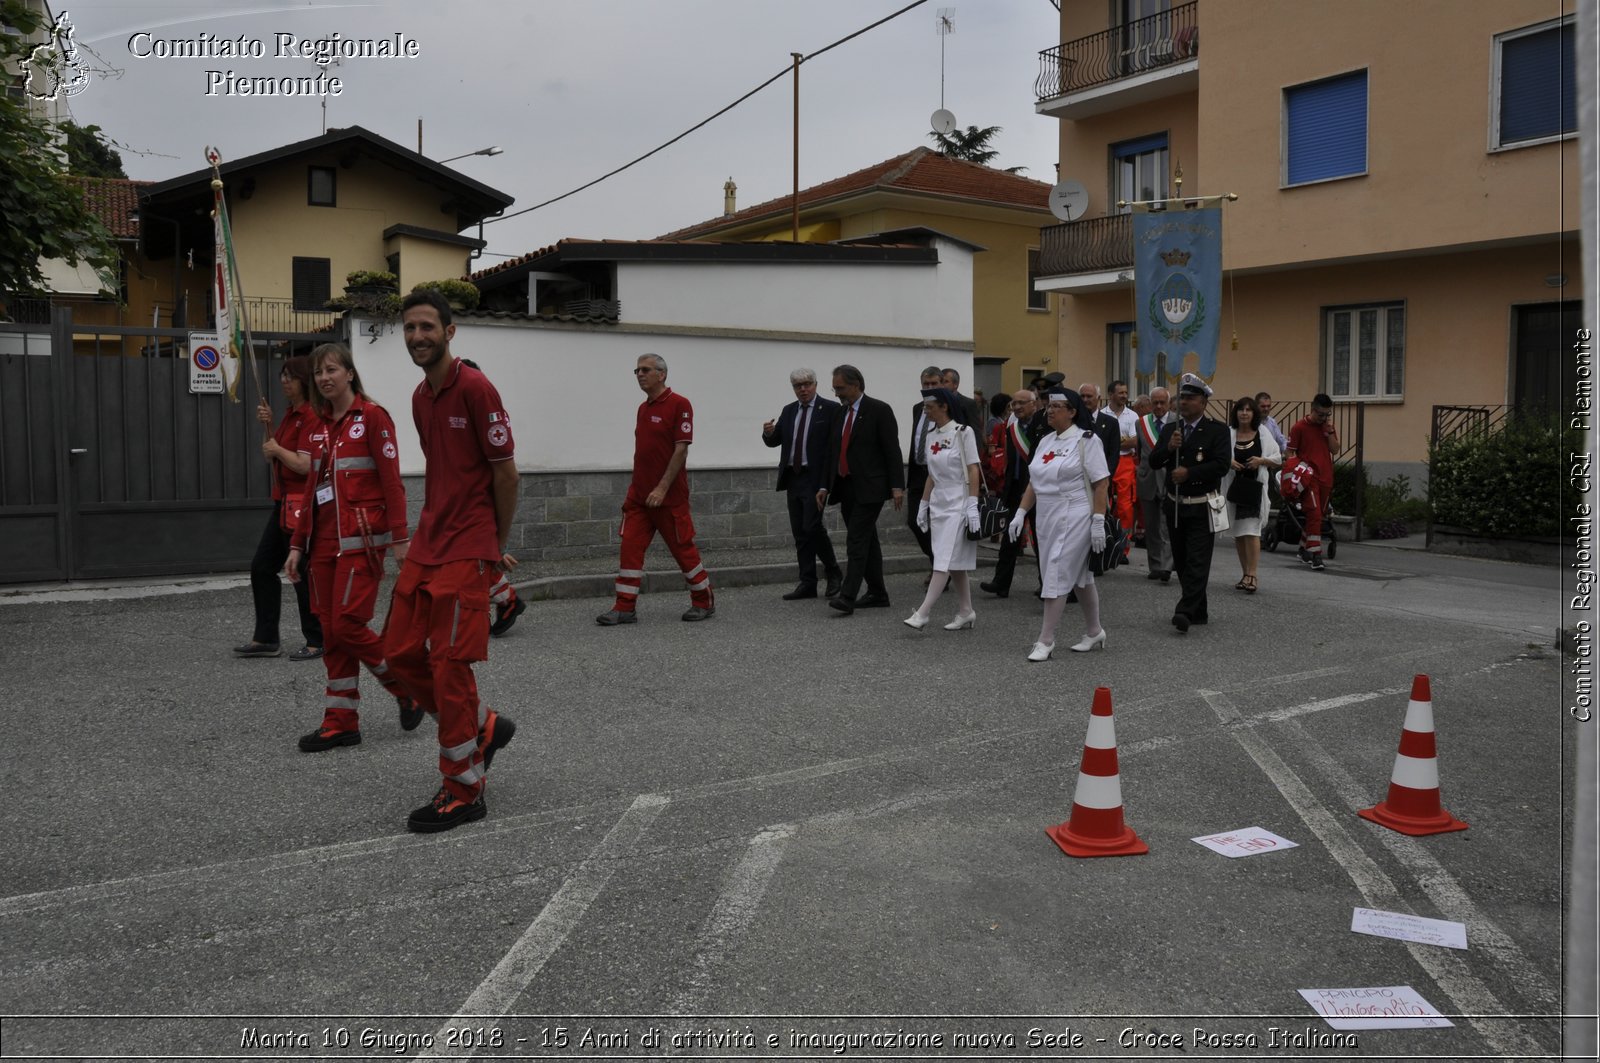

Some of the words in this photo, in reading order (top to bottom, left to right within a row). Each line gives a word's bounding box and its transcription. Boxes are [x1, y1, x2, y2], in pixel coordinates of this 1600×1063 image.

[1200, 834, 1241, 846] THE
[1237, 837, 1277, 851] END
[1318, 989, 1394, 999] PRINCIPIO
